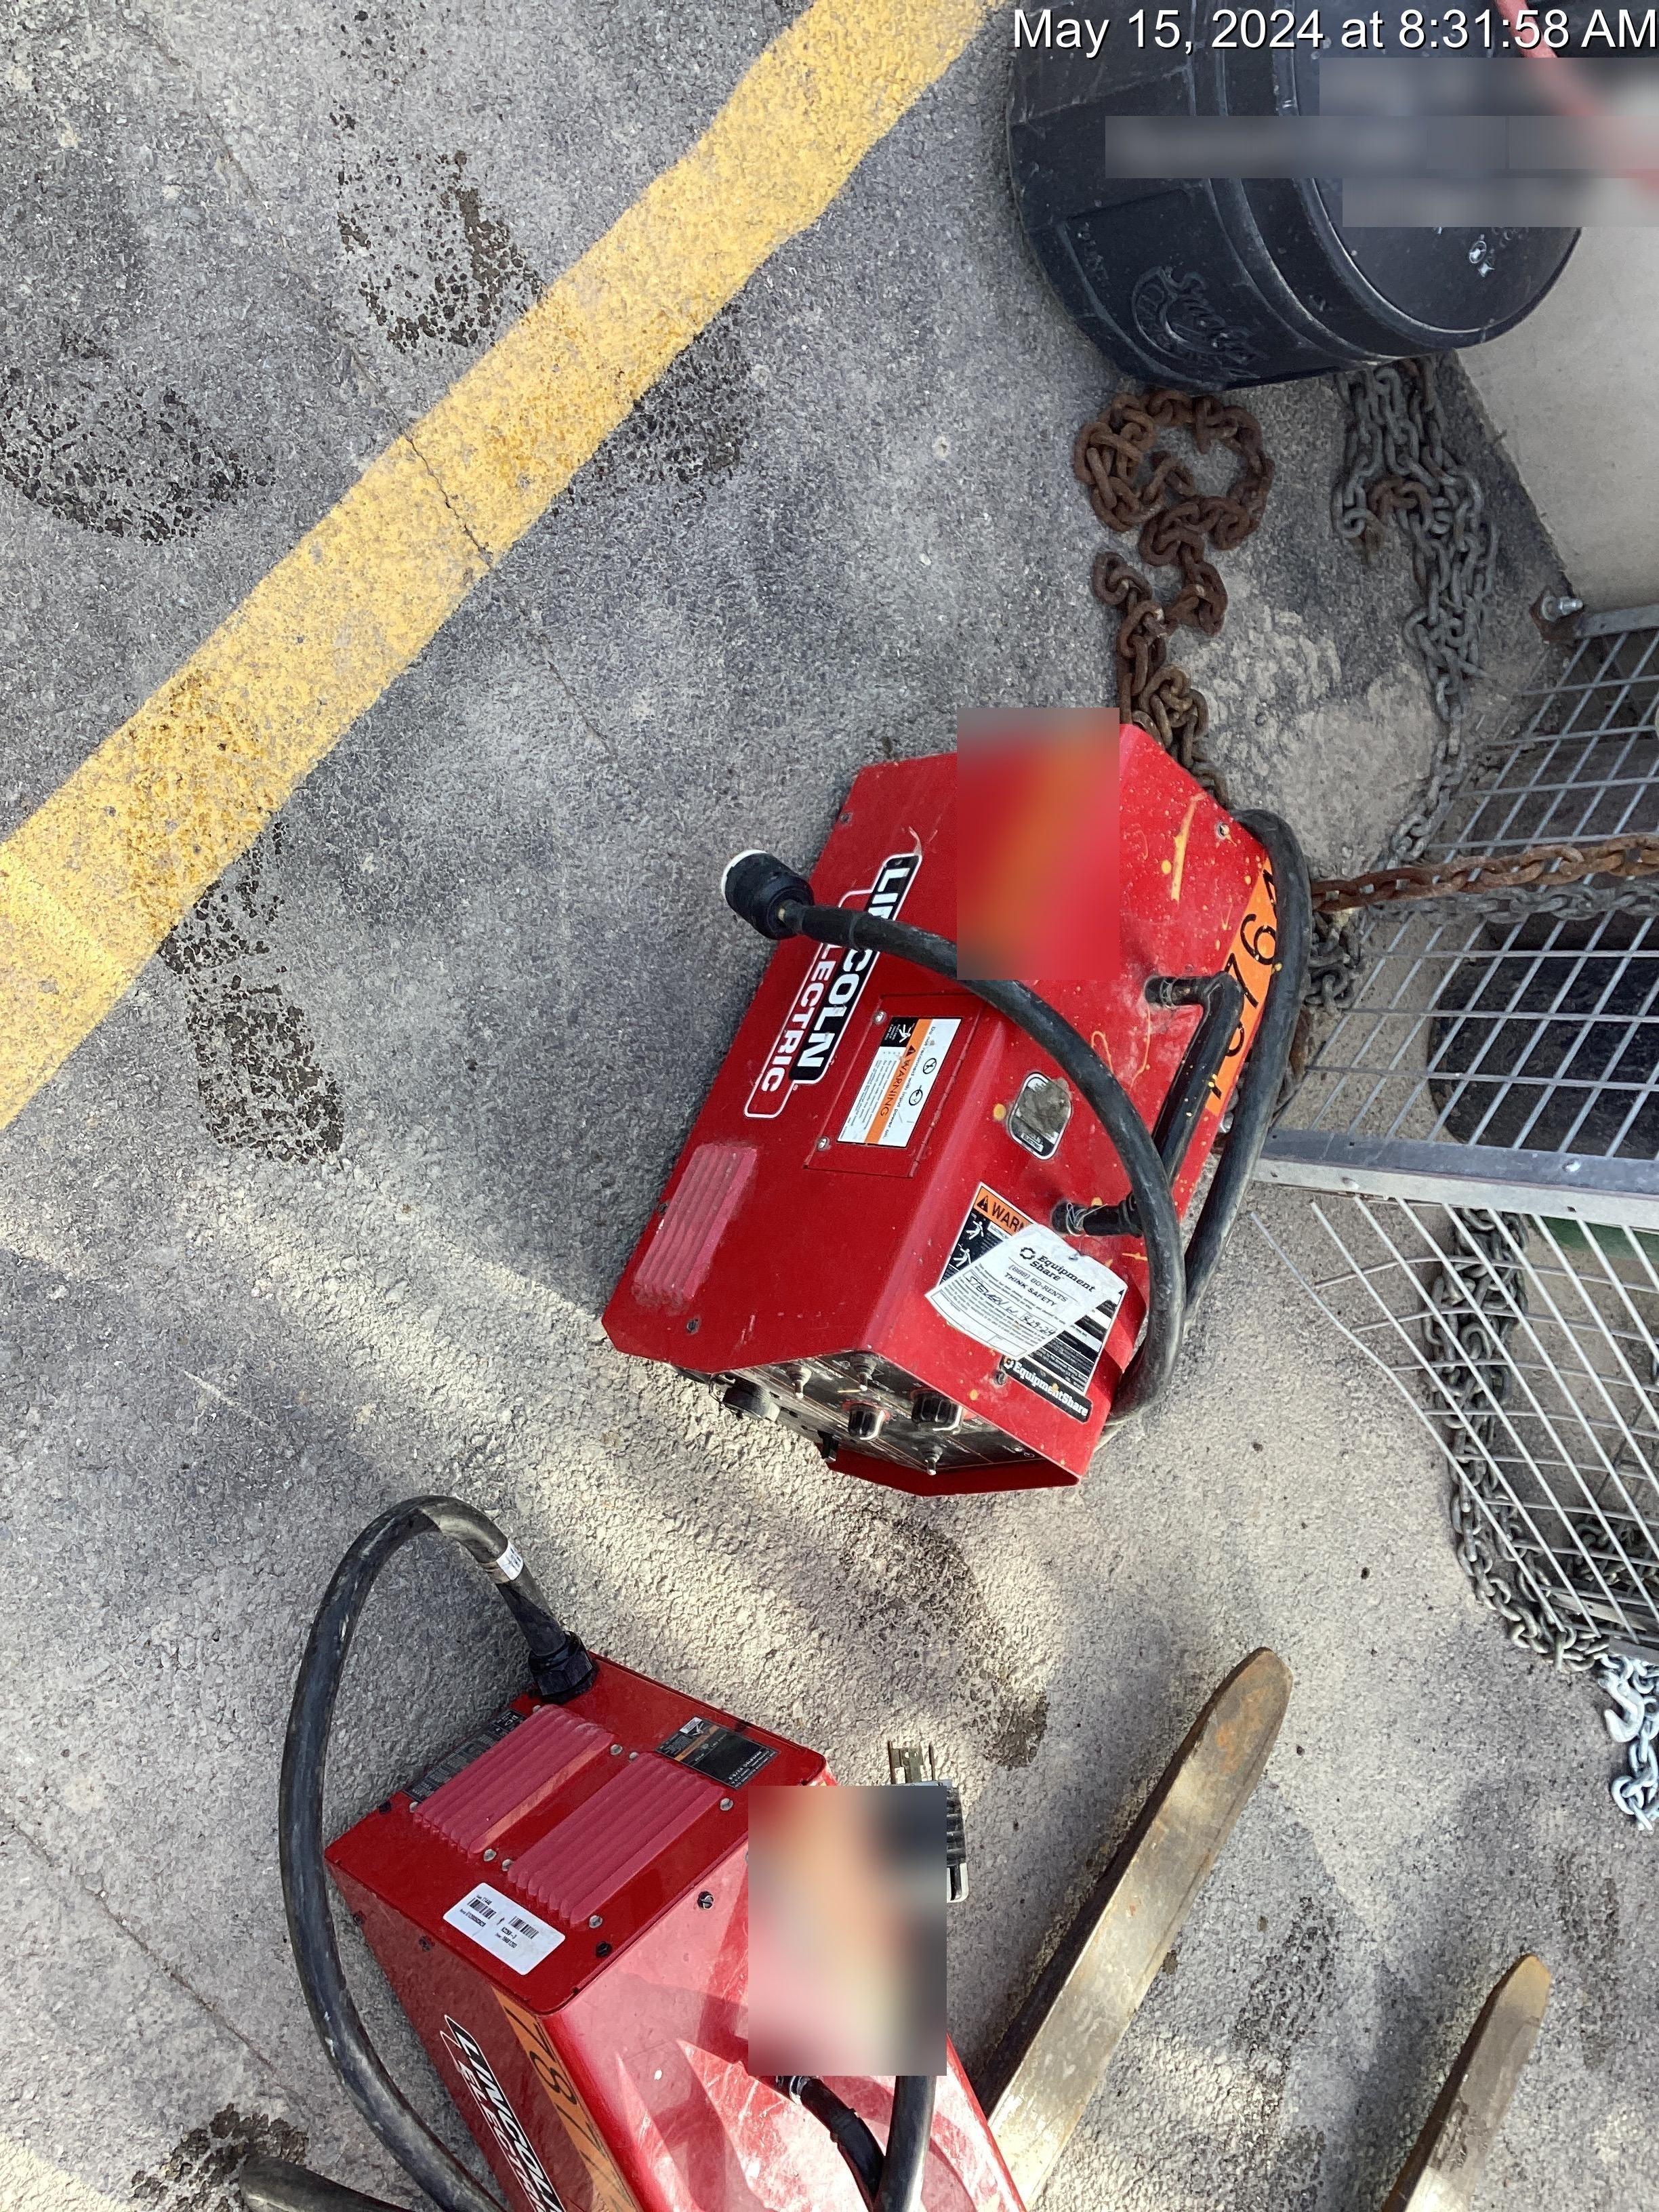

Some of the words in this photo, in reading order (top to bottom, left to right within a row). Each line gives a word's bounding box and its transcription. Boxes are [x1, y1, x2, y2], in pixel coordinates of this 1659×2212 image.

[760, 943, 842, 1092] LECTRIC
[879, 1060, 910, 1118] WARNING
[1004, 1272, 1027, 1288] THINK
[1027, 1287, 1057, 1307] SAFETY
[1029, 1260, 1061, 1281] Share
[1037, 1254, 1096, 1292] Equipment
[1015, 1362, 1088, 1416] EquipmentShare
[457, 2059, 546, 2212] ELECTRI
